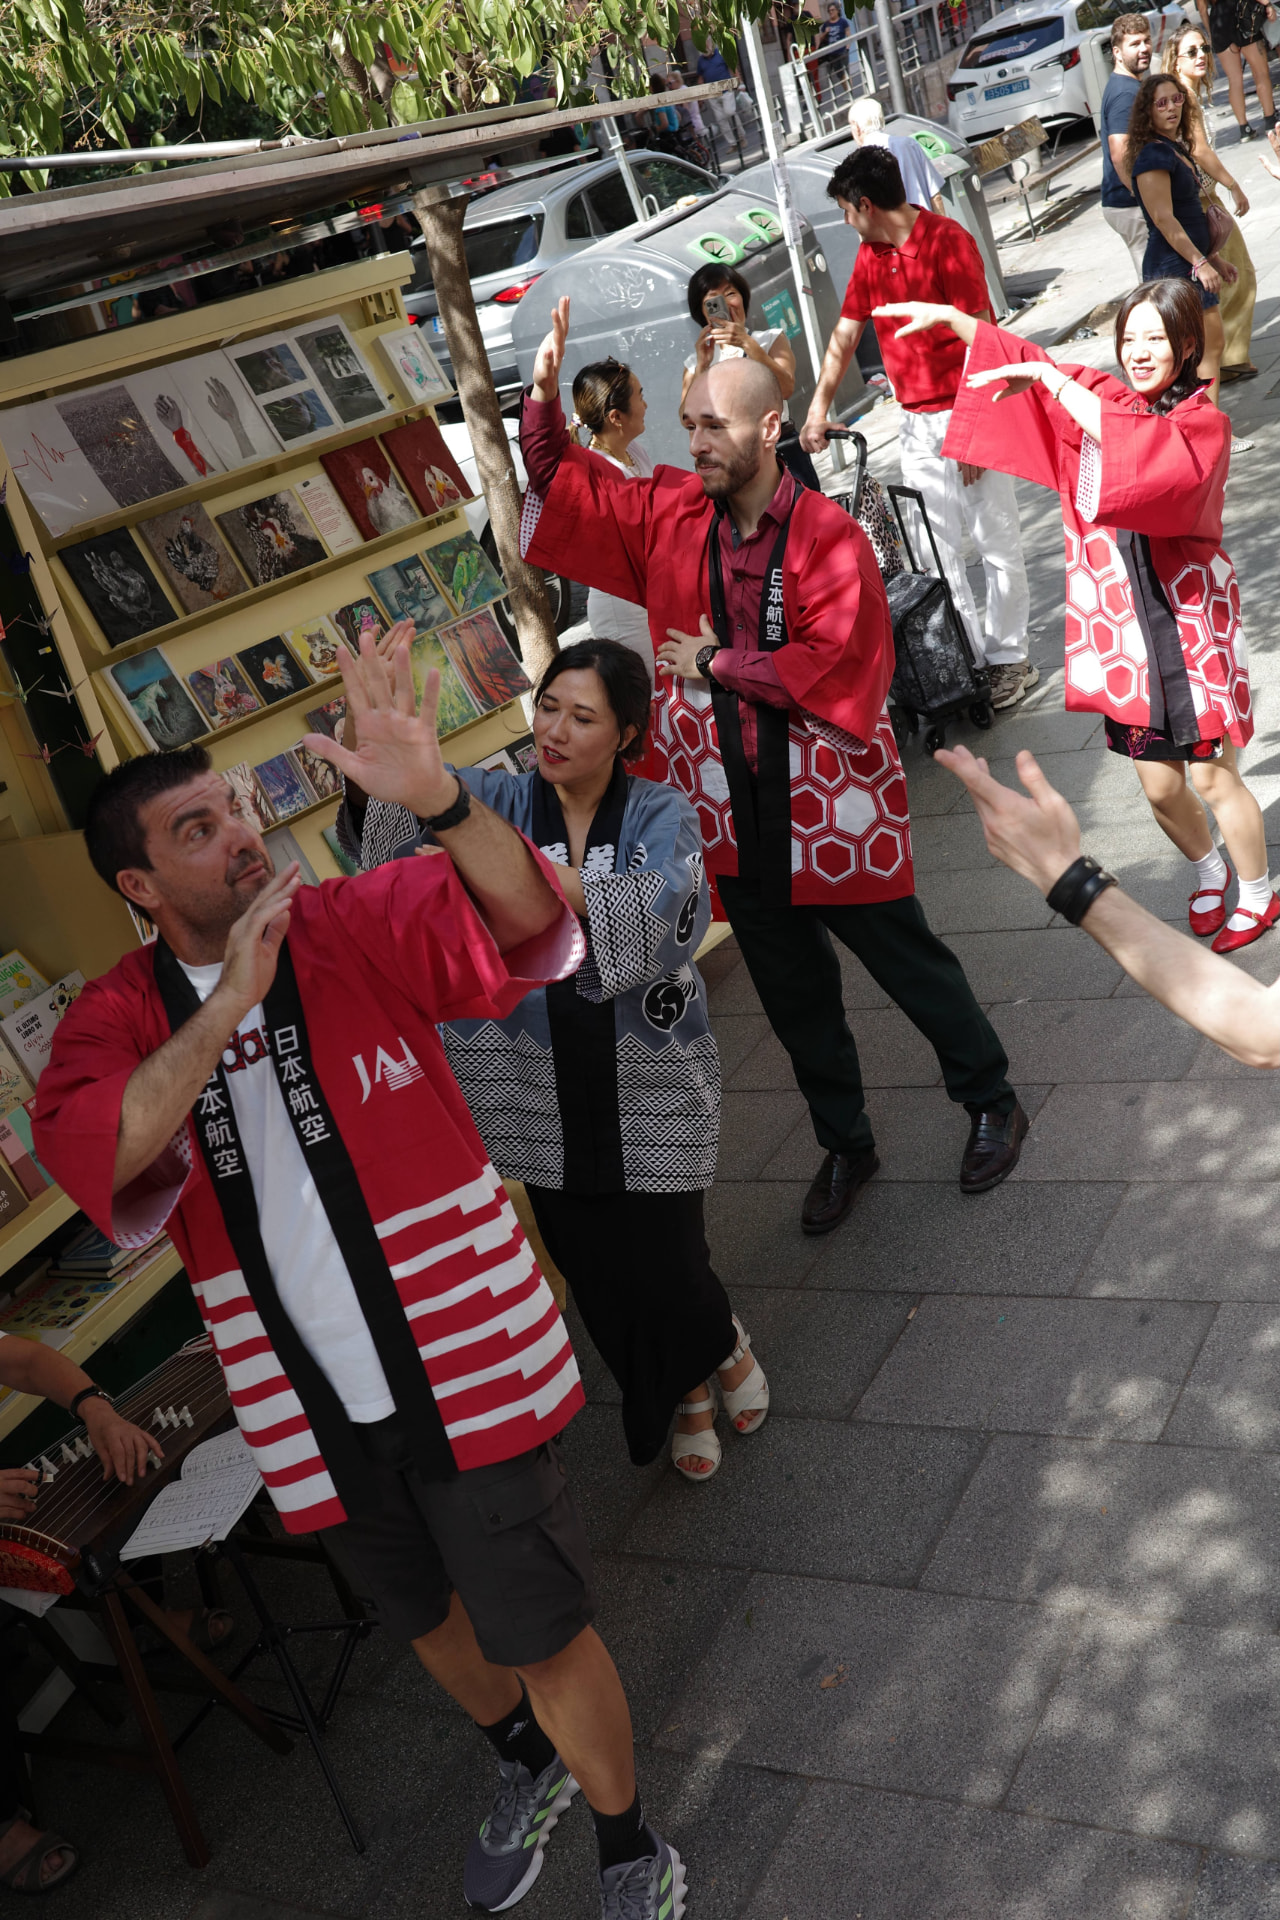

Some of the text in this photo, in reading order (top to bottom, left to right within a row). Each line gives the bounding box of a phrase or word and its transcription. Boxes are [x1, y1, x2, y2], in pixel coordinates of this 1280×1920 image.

[766, 568, 783, 641] 日本航空
[274, 1025, 331, 1146] 日本航空
[352, 1036, 424, 1104] JAL
